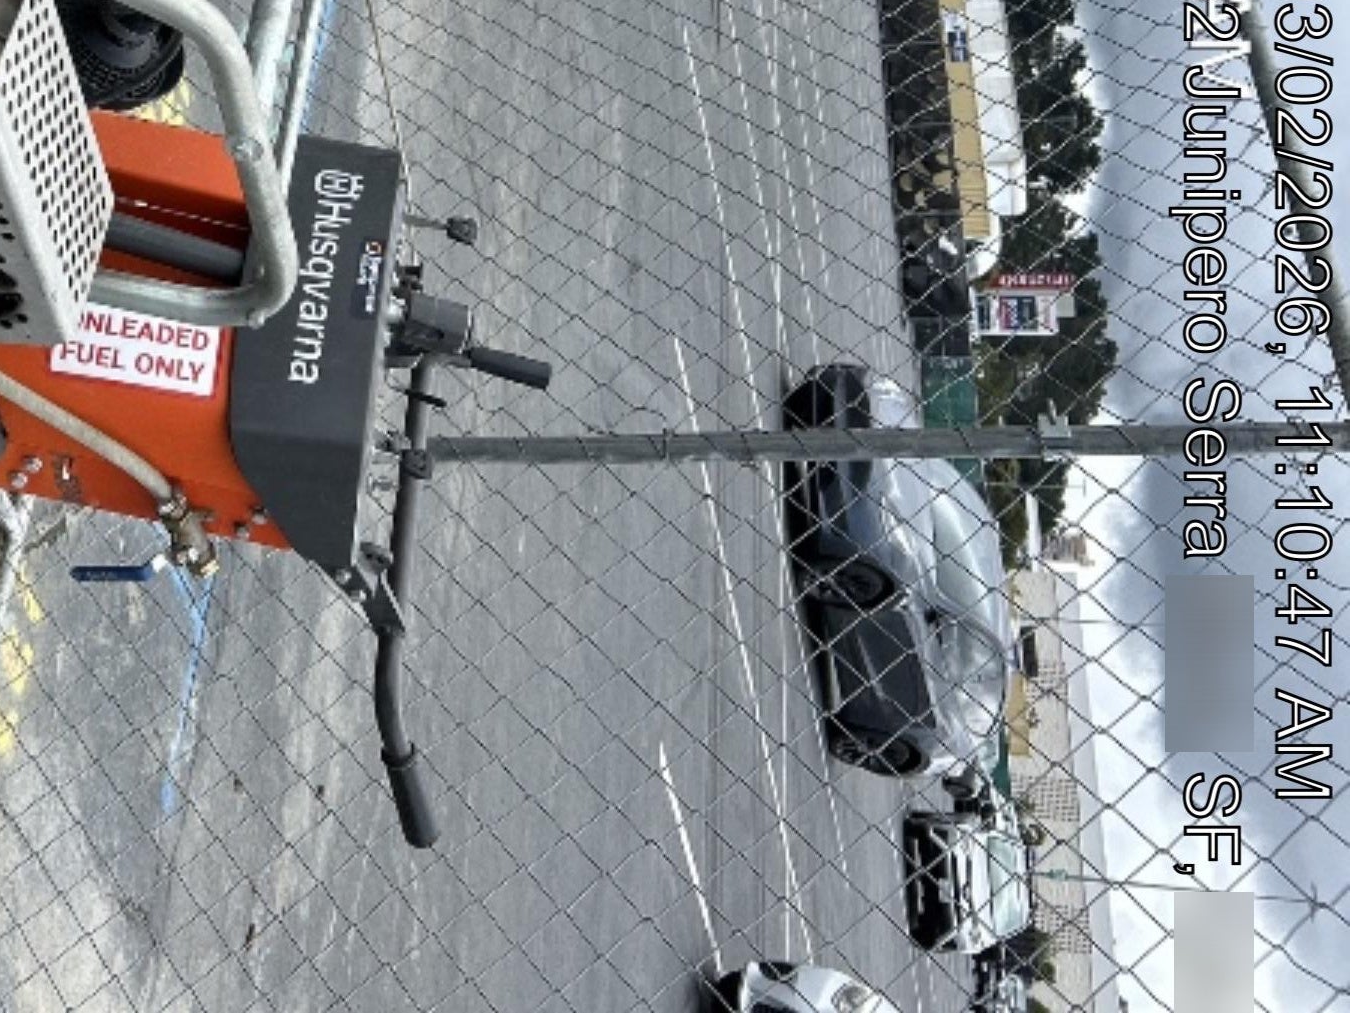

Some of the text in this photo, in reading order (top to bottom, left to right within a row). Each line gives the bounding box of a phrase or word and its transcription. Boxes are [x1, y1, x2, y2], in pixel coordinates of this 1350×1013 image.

[288, 199, 353, 385] Husqvarna
[60, 341, 205, 384] FUEL ONLY
